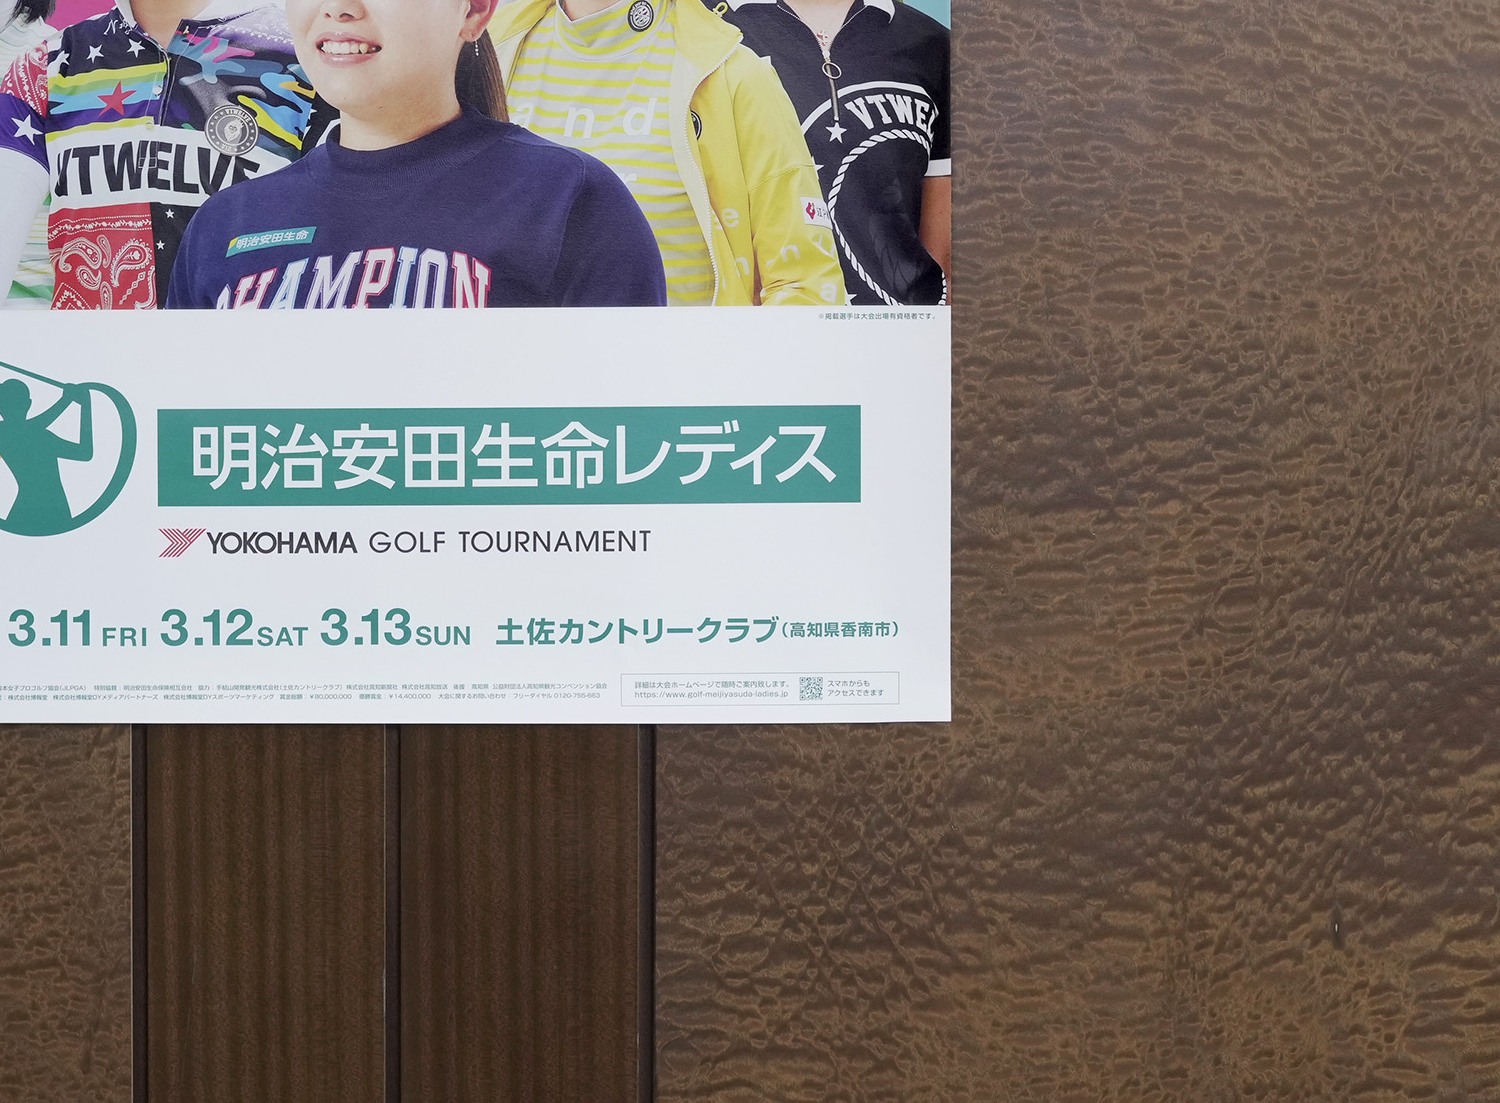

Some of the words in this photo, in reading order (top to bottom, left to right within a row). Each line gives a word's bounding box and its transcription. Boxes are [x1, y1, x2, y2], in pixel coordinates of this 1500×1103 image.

[235, 228, 310, 250] 明治安田生命
[192, 420, 837, 490] 明治安田生命レディス
[205, 530, 359, 555] YOKOHAMA
[368, 530, 447, 554] GOLF
[457, 529, 652, 553] TOURNAMENT
[8, 608, 92, 647] 3.11
[102, 627, 148, 647] FRI
[160, 608, 254, 647] 3.12
[256, 626, 309, 646] SAT
[320, 608, 412, 646] 3.13
[415, 625, 471, 646] SUN
[634, 680, 789, 690] 詳細は大会ホームページで随時ご案内致します。
[827, 679, 871, 688] スマホからも
[634, 690, 789, 700] https://www.golf-meijiyasuda-ladies.jp
[827, 689, 884, 698] アクセスできます
